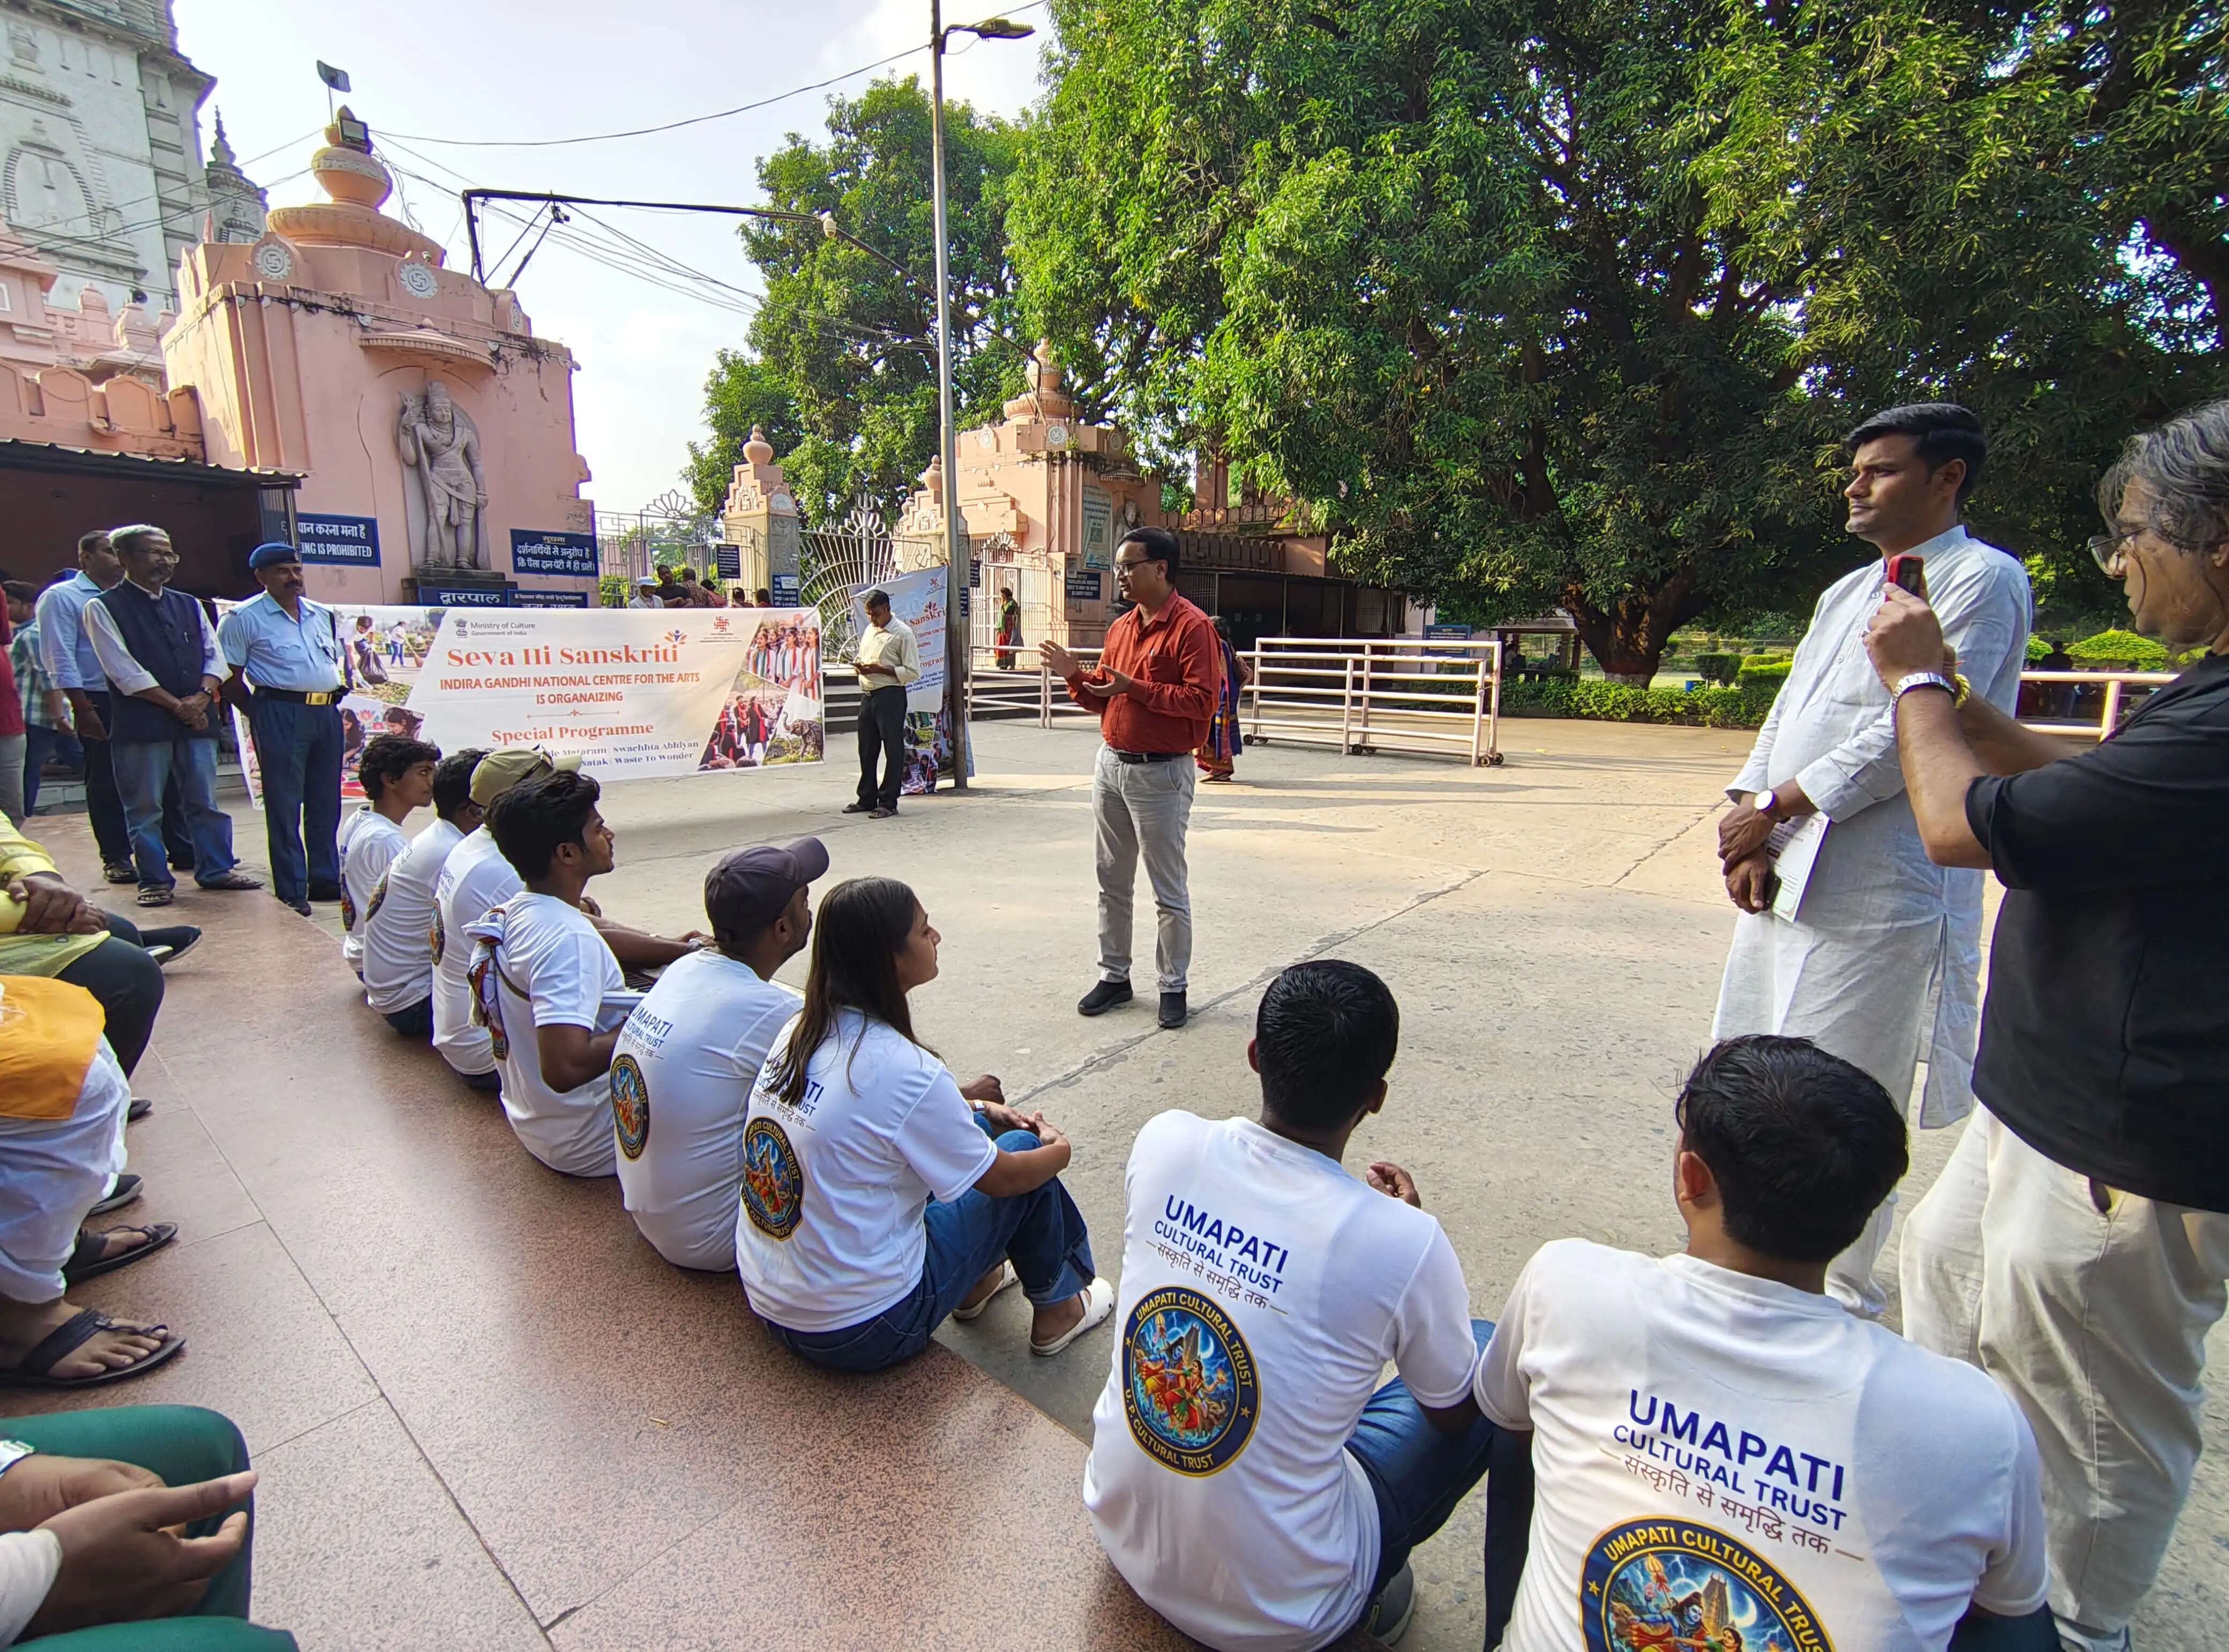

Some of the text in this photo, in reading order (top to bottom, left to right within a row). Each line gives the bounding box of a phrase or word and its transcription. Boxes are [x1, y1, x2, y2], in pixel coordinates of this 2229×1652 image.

[316, 523, 339, 536] करना
[340, 524, 357, 537] मना
[357, 523, 365, 539] है
[318, 543, 325, 555] IS
[326, 544, 372, 557] PROHIBITED
[552, 546, 559, 557] से
[560, 546, 584, 558] अनुरोध
[517, 557, 526, 567] कि
[573, 560, 580, 572] ही
[439, 591, 502, 604] द्वारपाल
[447, 644, 678, 667] Seva Hi Sanskriti
[440, 672, 700, 690] INDIRA GANDHI NATIONAL CENTRE FOR THE ARTS
[536, 692, 623, 704] IS ORGANAIZING
[492, 723, 654, 745] Special Programme
[612, 744, 660, 753] Swachhta
[663, 741, 699, 750] Abhiyan
[615, 755, 643, 764] Waste
[659, 752, 694, 761] Wonder
[644, 1033, 665, 1049] TRUST
[794, 1114, 806, 1128] तक
[762, 1121, 788, 1151] CULTURAL
[786, 1148, 801, 1181] TRUST
[1165, 1195, 1289, 1274] UMAPATI
[1154, 1220, 1283, 1294] CULTURAL TRUST
[1157, 1241, 1269, 1309] संस्कृति से समृद्धि तक
[1135, 1291, 1253, 1389] UMAPATI CULTURAL TRUST
[1133, 1418, 1179, 1466] CULTURAL
[1181, 1453, 1214, 1469] TRUST
[1629, 1388, 1845, 1501] UMAPATI
[1613, 1425, 1847, 1531] CULTURAL TRUST
[1625, 1453, 1832, 1554] संस्कृति से समृद्धि तक
[1603, 1526, 1677, 1563] UMAPATI
[1681, 1529, 1785, 1603] CULTURAL
